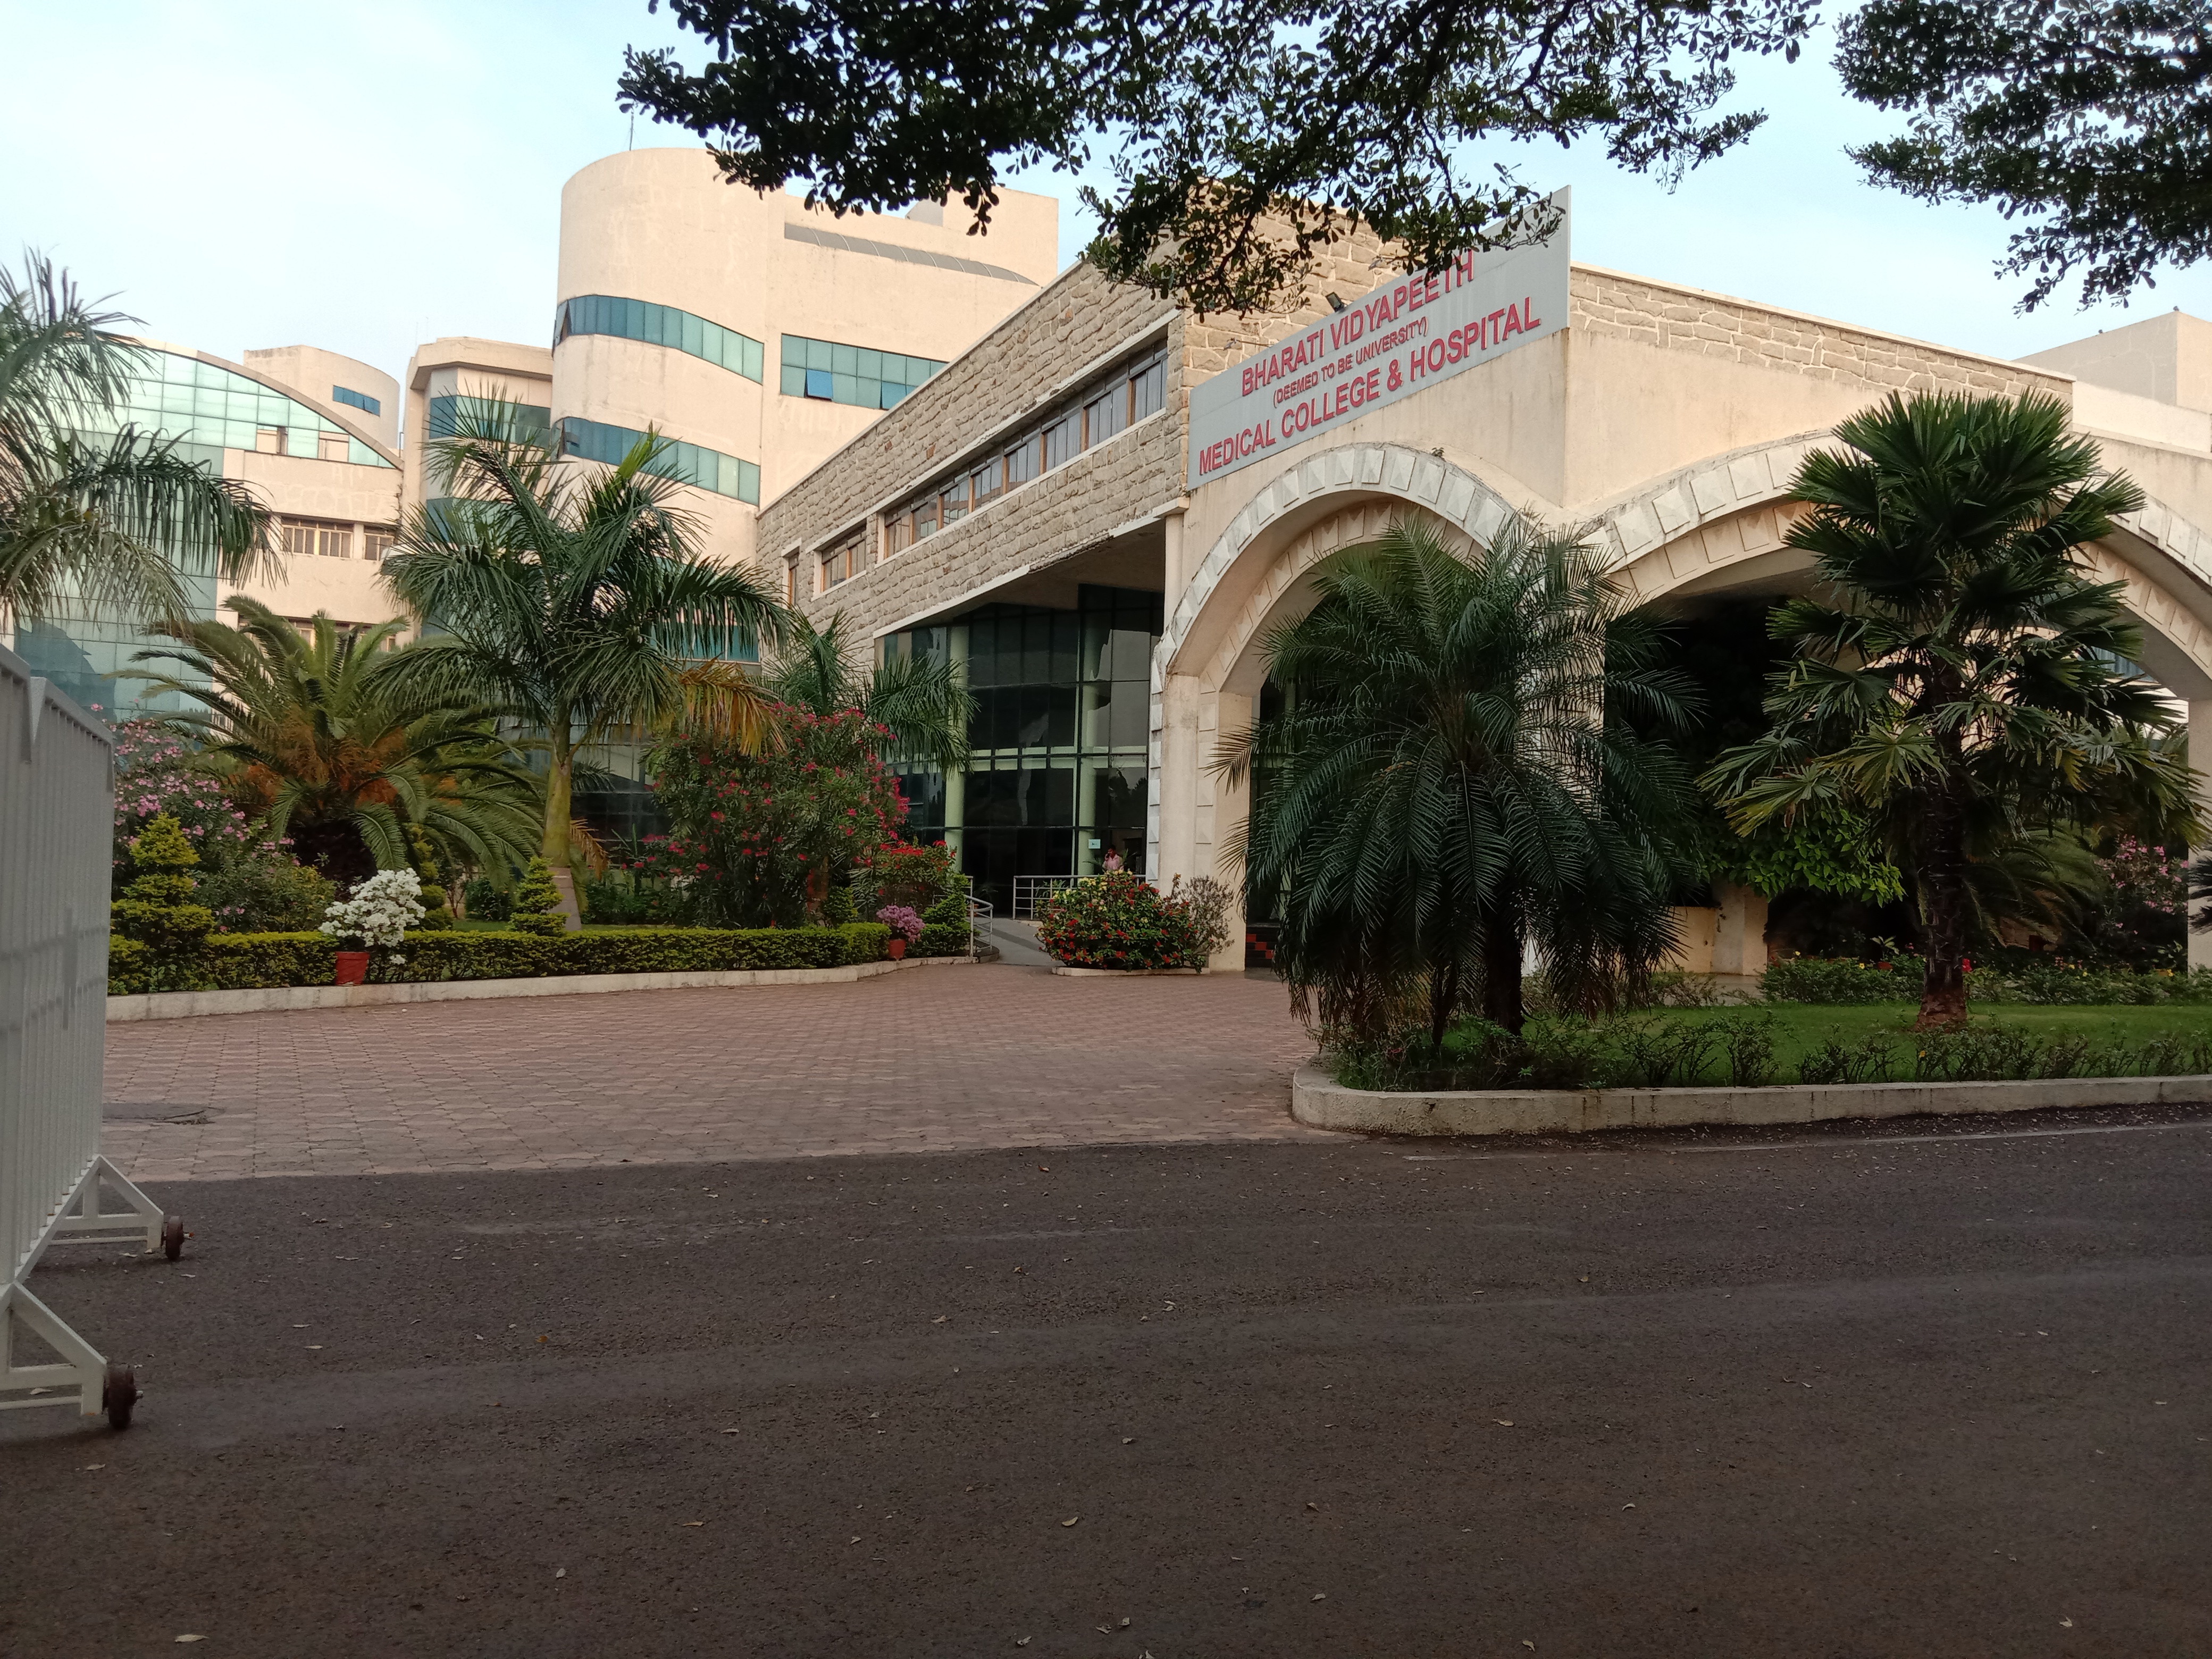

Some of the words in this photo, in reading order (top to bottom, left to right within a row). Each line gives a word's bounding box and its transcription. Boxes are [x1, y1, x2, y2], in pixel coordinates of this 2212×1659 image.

[1199, 419, 1276, 475] MEDICAL
[1281, 367, 1380, 438] COLLEGE
[1387, 359, 1403, 391] &
[1410, 296, 1541, 382] HOSPITAL
[1242, 329, 1324, 397] BHARATI
[1330, 248, 1473, 350] VIDYAPEETH
[1273, 371, 1319, 408] (DEEMED
[1321, 363, 1336, 381] TO
[1338, 353, 1353, 374] BE
[1356, 316, 1428, 365] UNIVERSITY)
